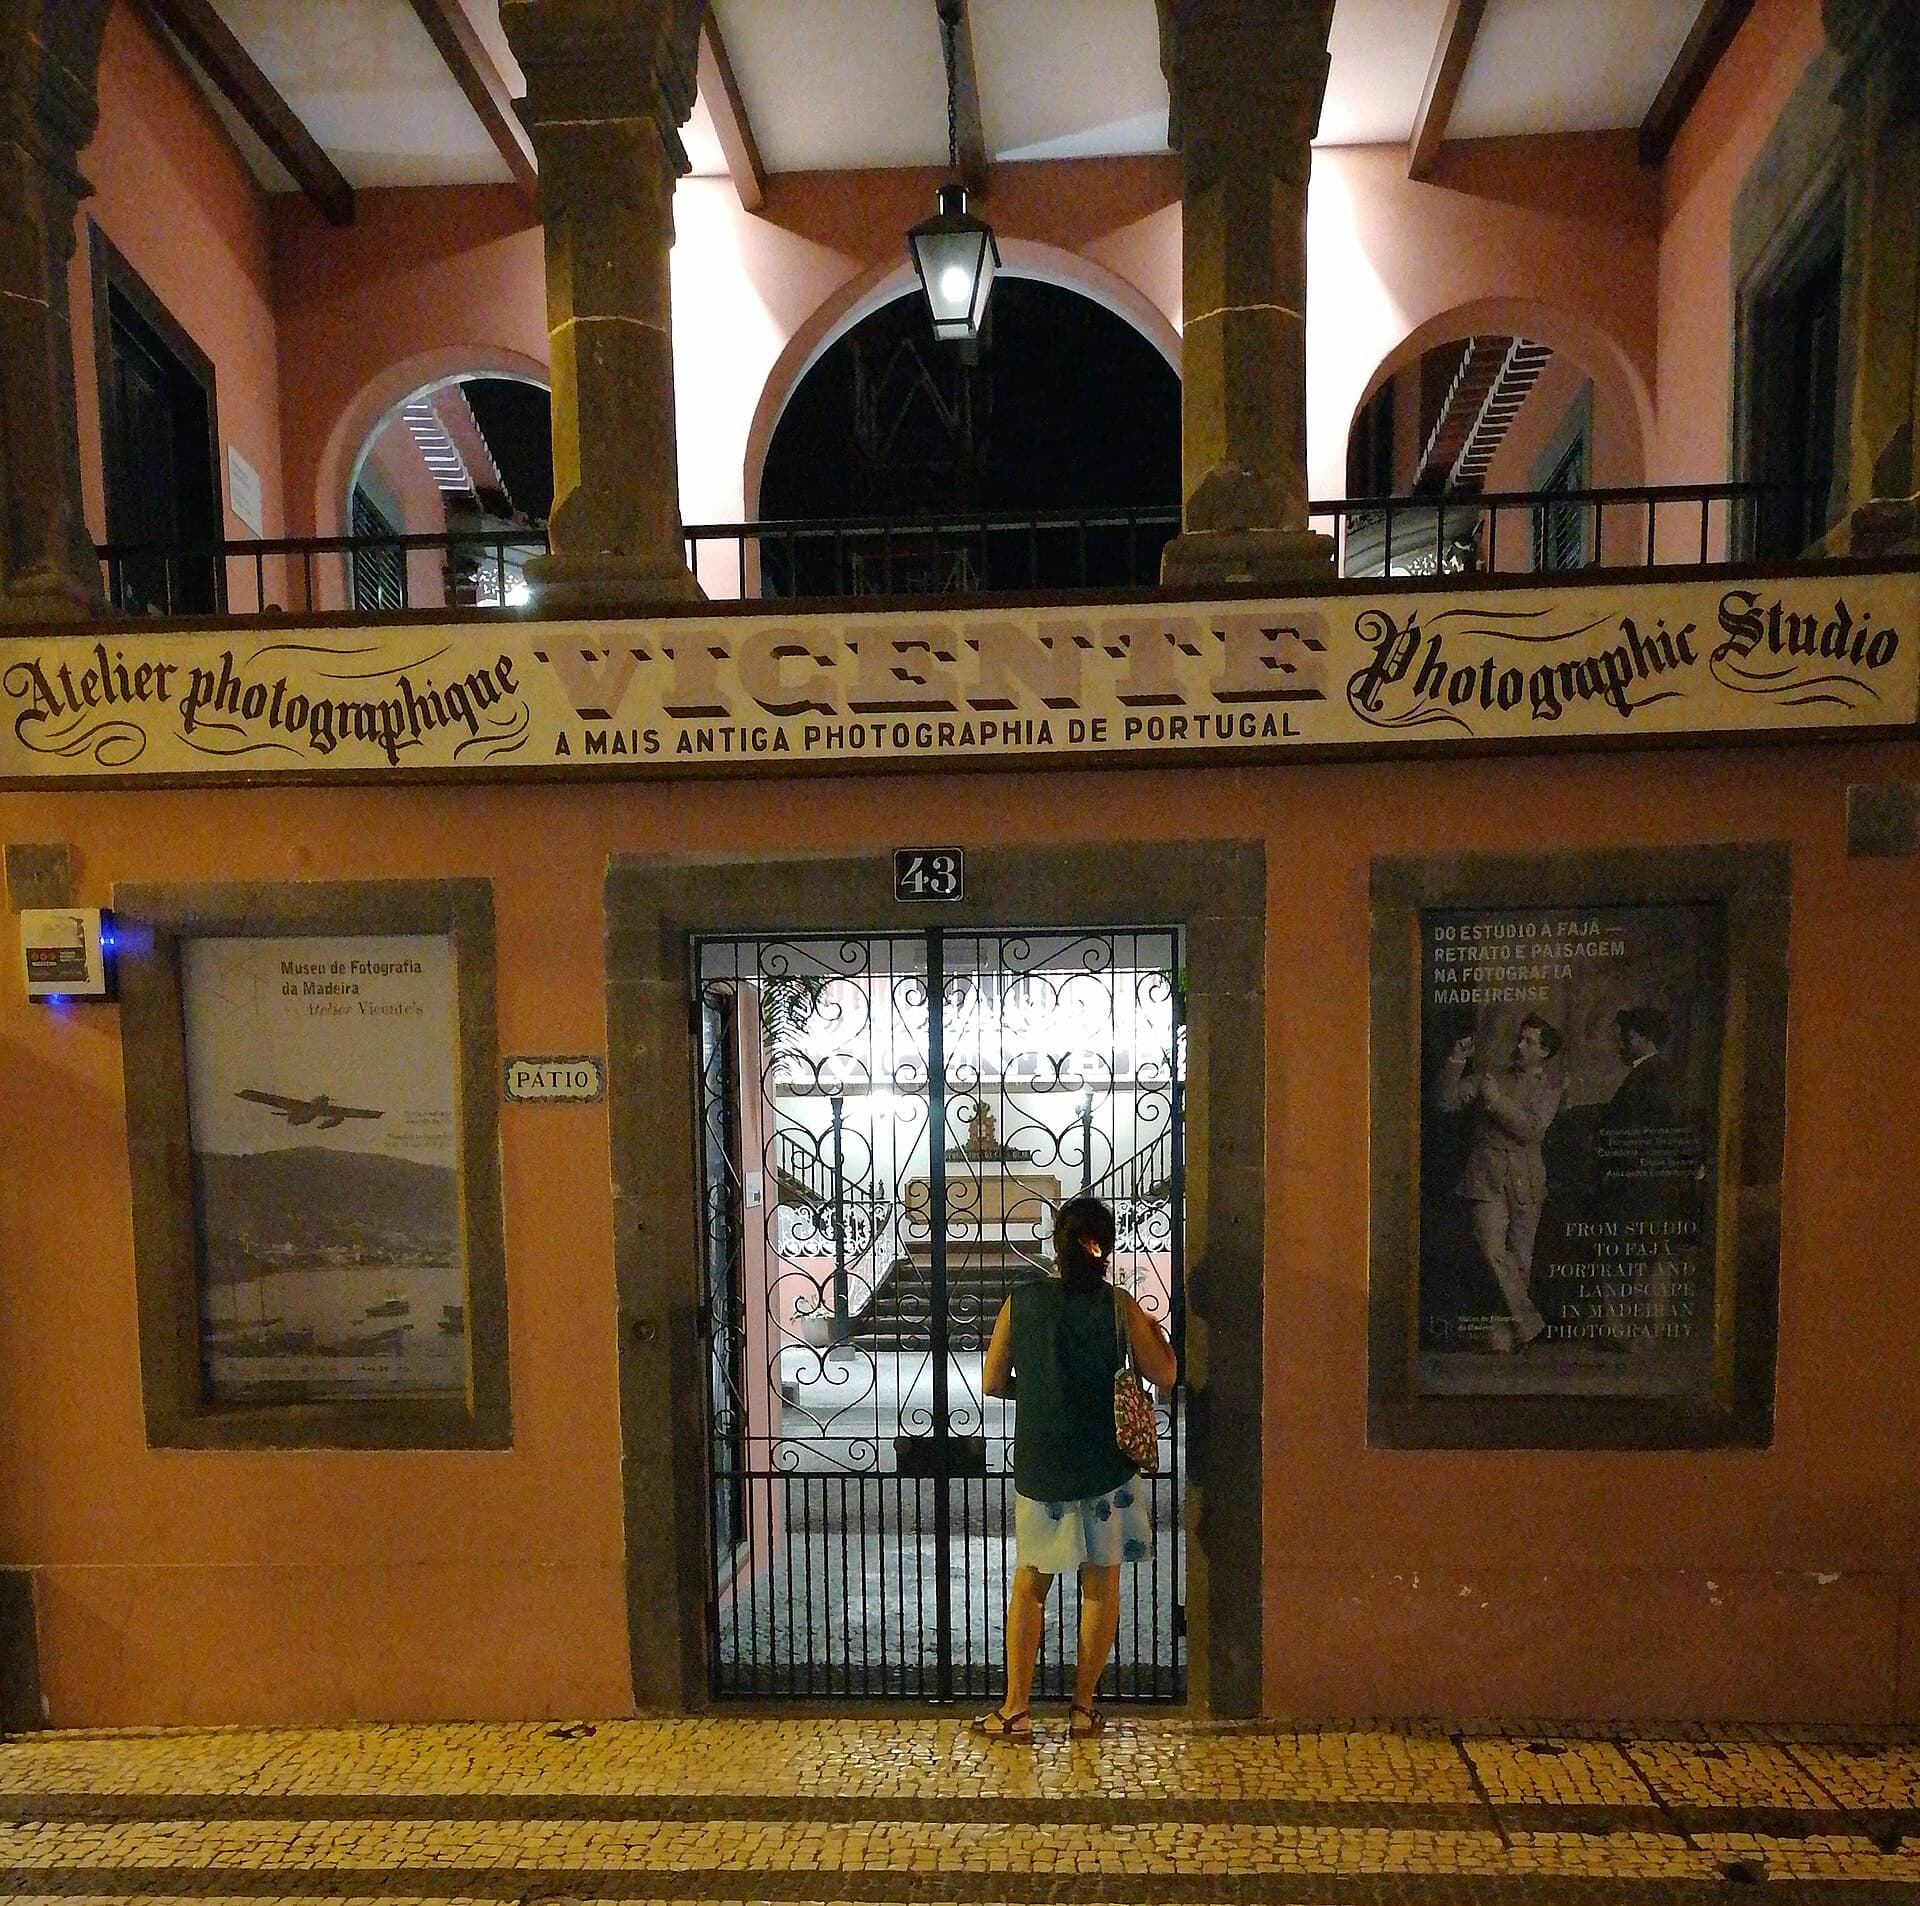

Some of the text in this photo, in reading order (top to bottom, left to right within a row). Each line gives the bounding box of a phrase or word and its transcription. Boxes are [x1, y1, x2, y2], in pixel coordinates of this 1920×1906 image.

[1349, 590, 1898, 721] Photographic Studio
[531, 611, 1328, 720] VICENTE
[3, 642, 521, 765] Atelier photographique
[554, 710, 1302, 756] A MAIS ANTIGA PHOTOGRAPHIA DE PORTUGAL
[900, 856, 957, 894] 43
[1434, 926, 1457, 942] DO
[1434, 941, 1626, 963] RETRATO E PAISAGEM
[280, 959, 423, 977] Museu de Fotografia
[1434, 964, 1574, 984] NA FOTOGRAFIA
[282, 981, 360, 996] da Madeira
[1434, 986, 1550, 1004] MADEIRENSE
[1565, 1220, 1698, 1237] FROM STUDIO
[1594, 1242, 1619, 1257] TO
[1549, 1262, 1647, 1278] PORTRAIT
[1560, 1304, 1581, 1319] IN
